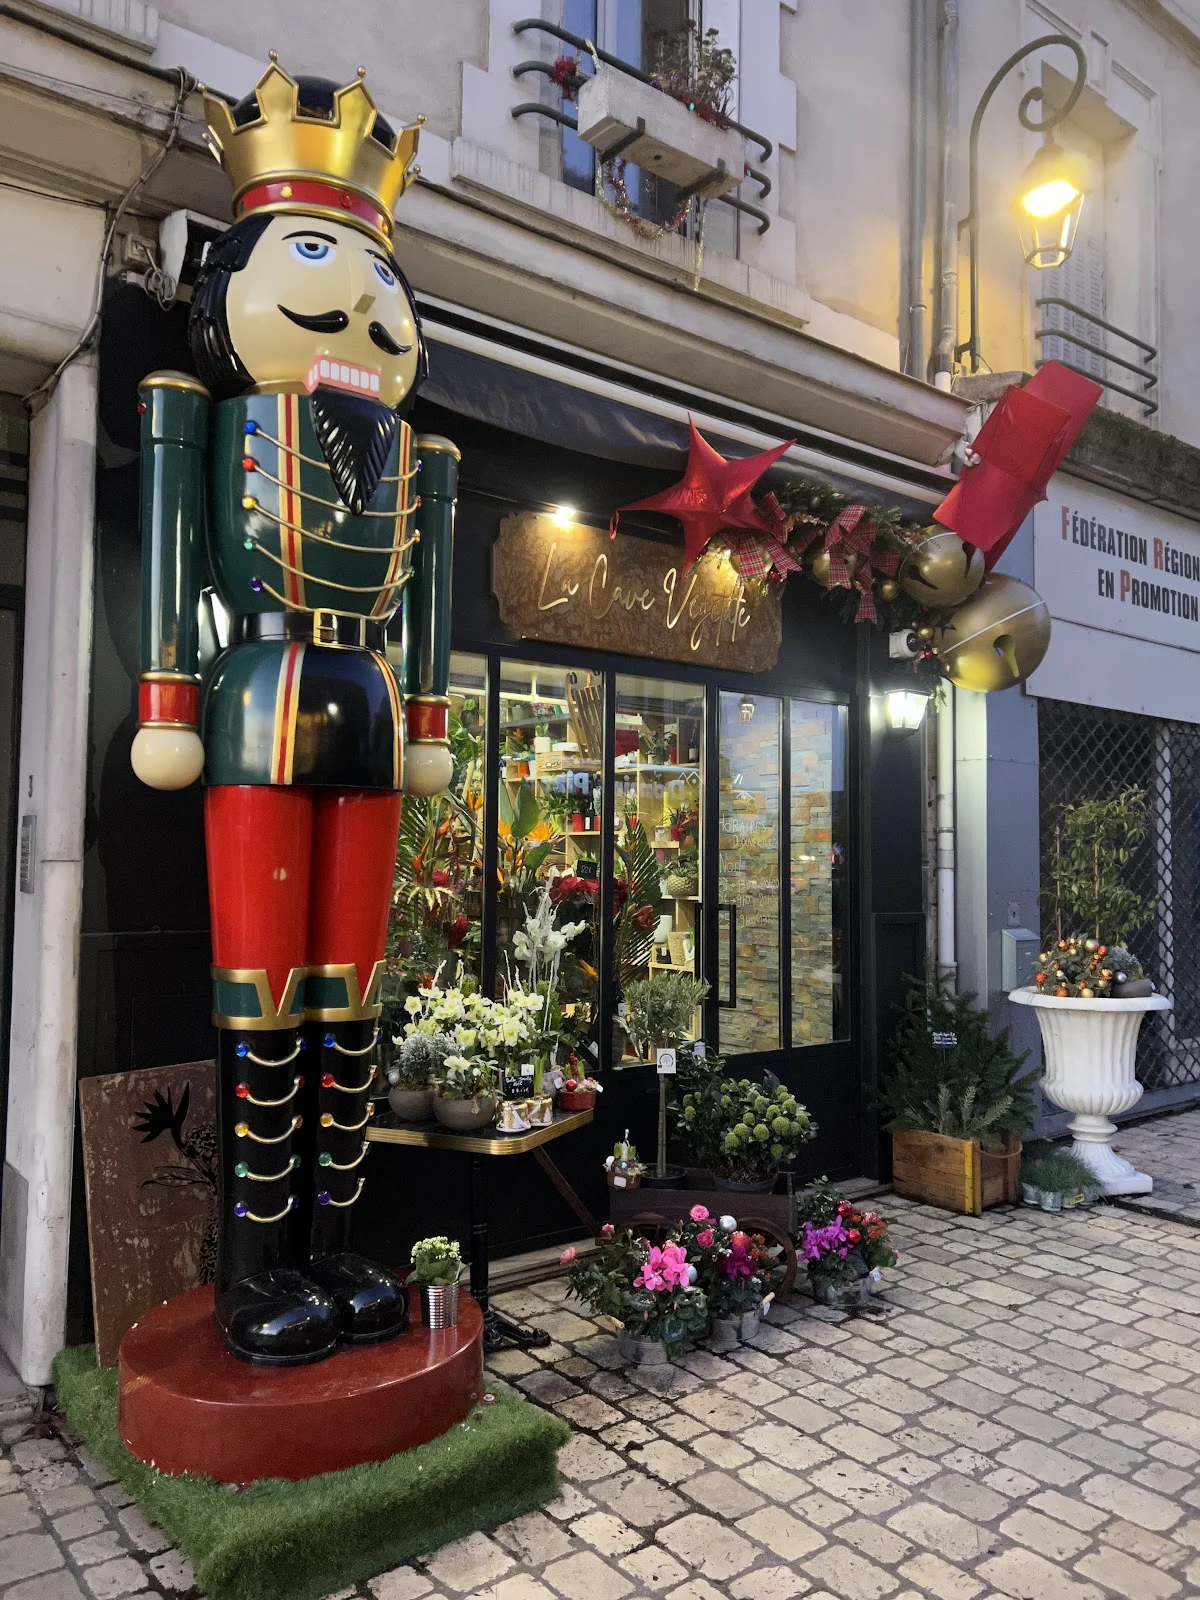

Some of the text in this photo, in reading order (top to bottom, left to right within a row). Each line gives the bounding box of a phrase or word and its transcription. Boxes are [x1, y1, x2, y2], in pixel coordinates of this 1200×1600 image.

[1061, 506, 1148, 566] FÉDÉRATION
[537, 542, 580, 611] La
[588, 553, 656, 620] Cave
[1098, 568, 1199, 622] EN PROMOTION
